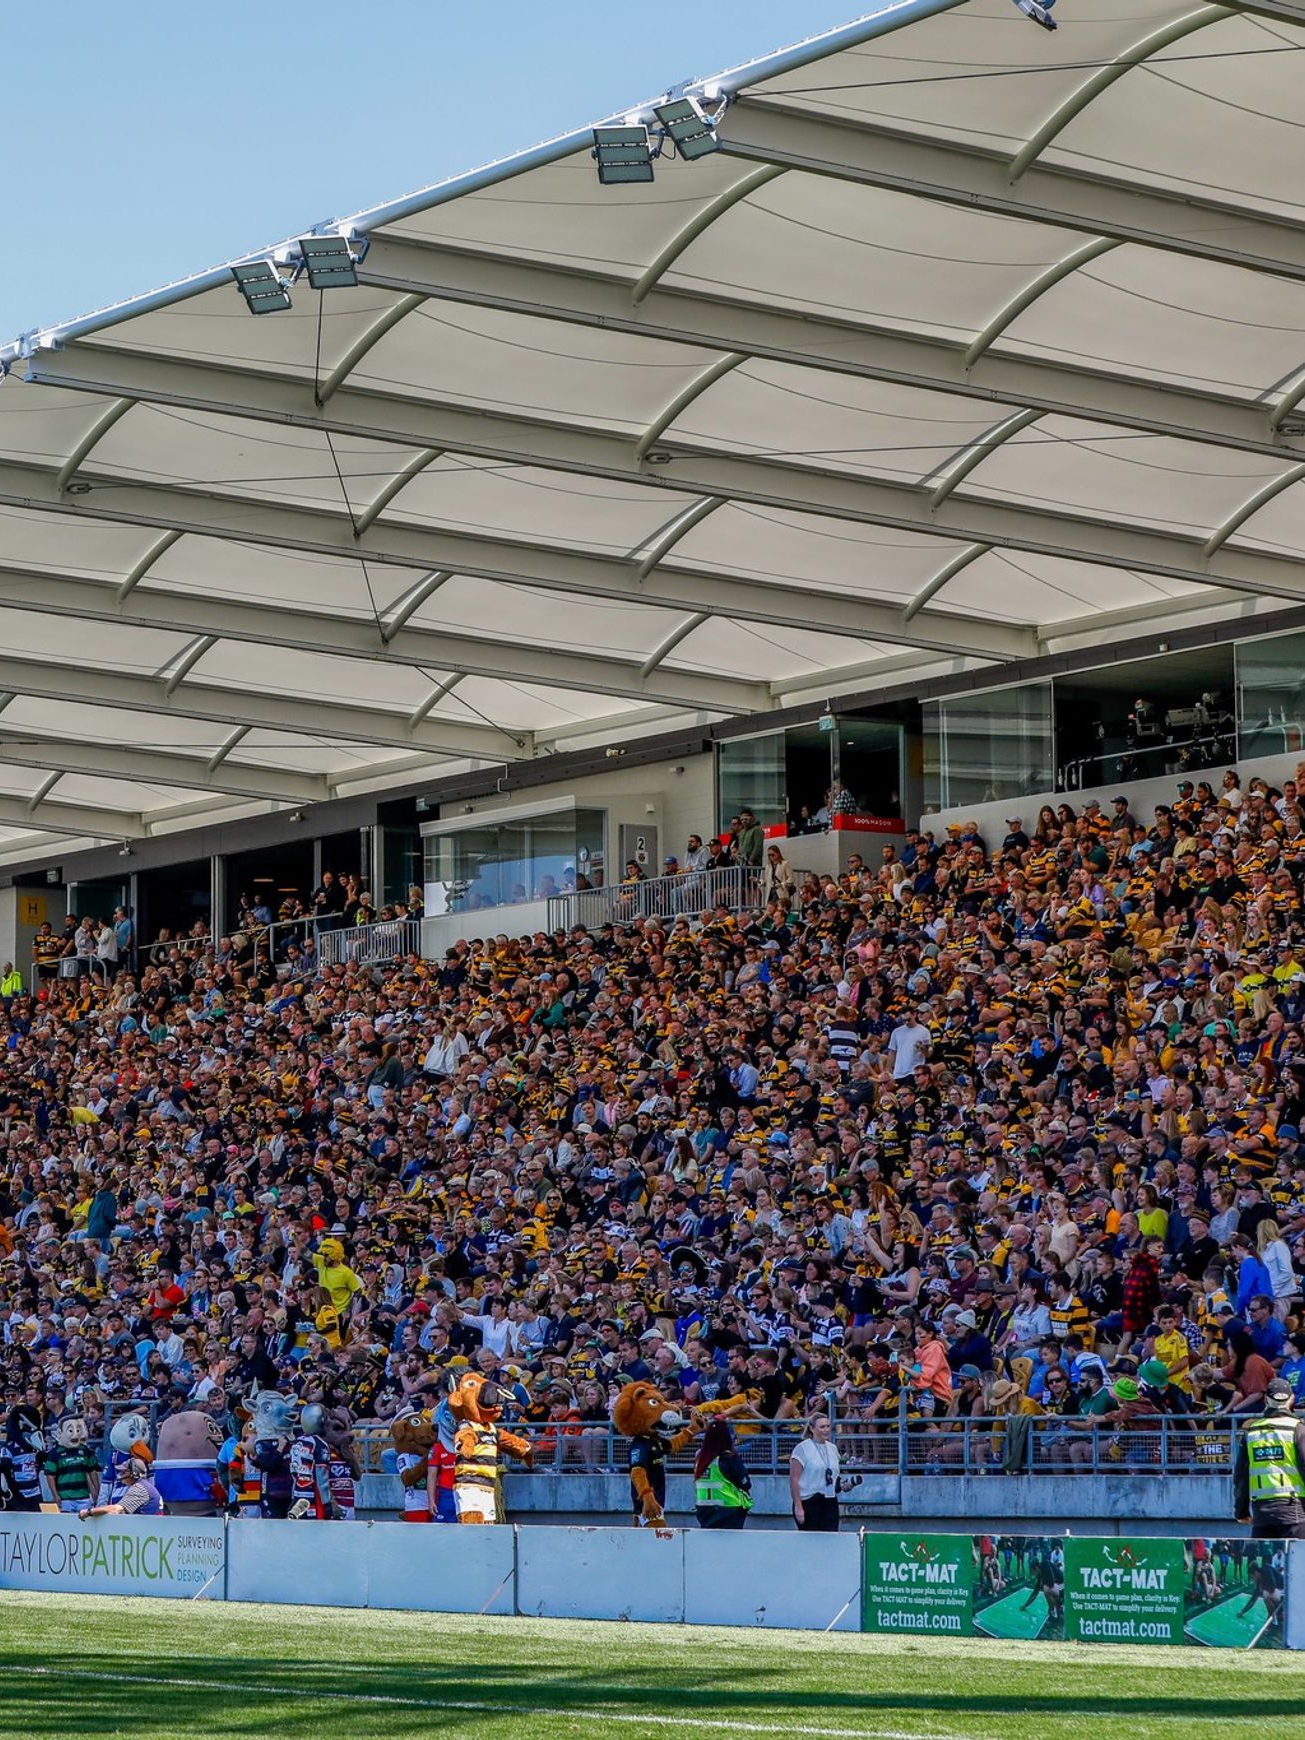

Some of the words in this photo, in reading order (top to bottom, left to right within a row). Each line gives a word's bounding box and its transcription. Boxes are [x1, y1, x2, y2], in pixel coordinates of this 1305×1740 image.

[638, 838, 644, 850] 2
[28, 903, 37, 914] H
[1203, 1444, 1223, 1454] THE
[177, 1536, 223, 1550] SURVEYING
[177, 1554, 219, 1566] PLANNING
[177, 1568, 207, 1582] DESIGN
[879, 1562, 958, 1583] TACT-MAT
[1080, 1567, 1168, 1589] TACT-MAT
[911, 1587, 924, 1595] game
[1070, 1591, 1085, 1599] When
[1144, 1594, 1162, 1603] clarity
[882, 1595, 907, 1603] TACT-MAT
[1072, 1602, 1083, 1610] Use
[1084, 1603, 1111, 1611] TACT-MAT
[1119, 1604, 1140, 1613] simplify
[877, 1609, 961, 1629] tactmat.com
[1079, 1617, 1171, 1638] tactmat.com
